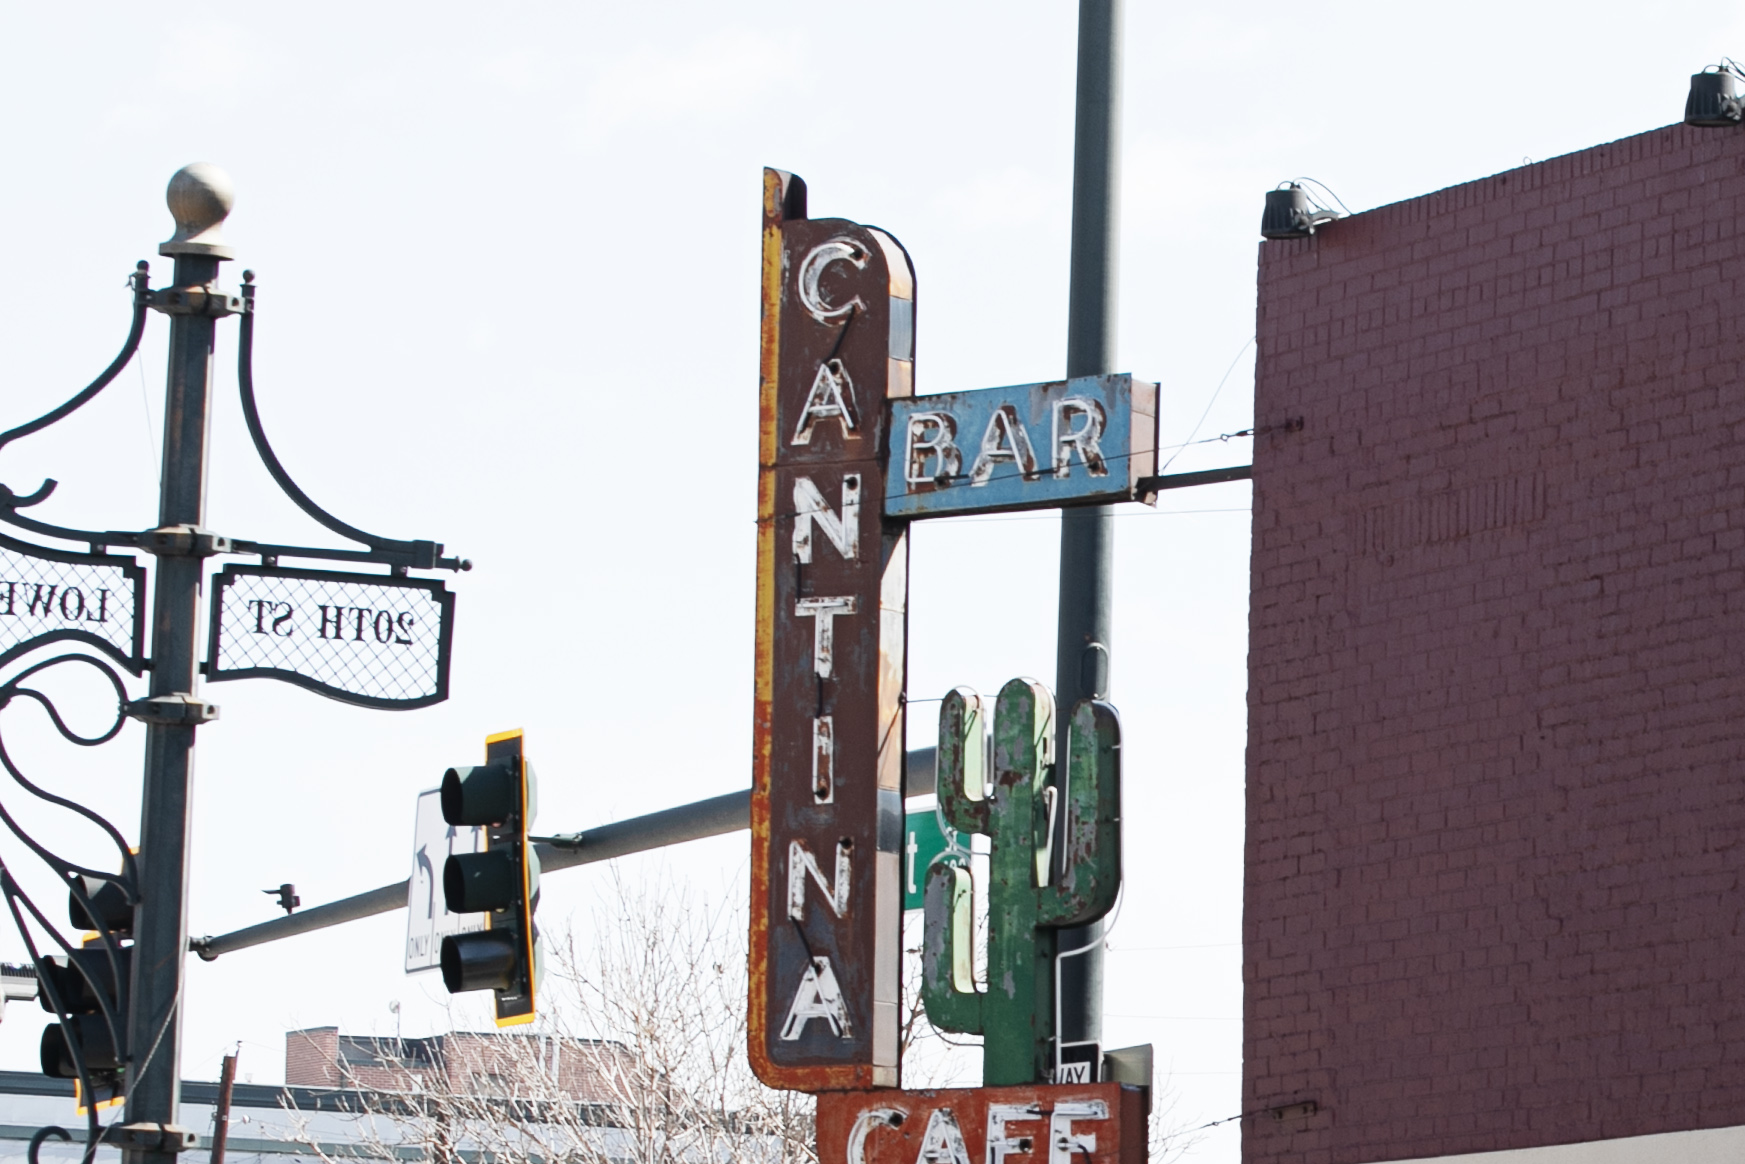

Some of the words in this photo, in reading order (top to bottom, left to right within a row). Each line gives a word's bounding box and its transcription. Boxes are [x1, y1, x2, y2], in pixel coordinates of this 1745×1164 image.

[905, 397, 1108, 493] BAR
[780, 235, 872, 1041] CANTINA
[1060, 1066, 1086, 1084] AY
